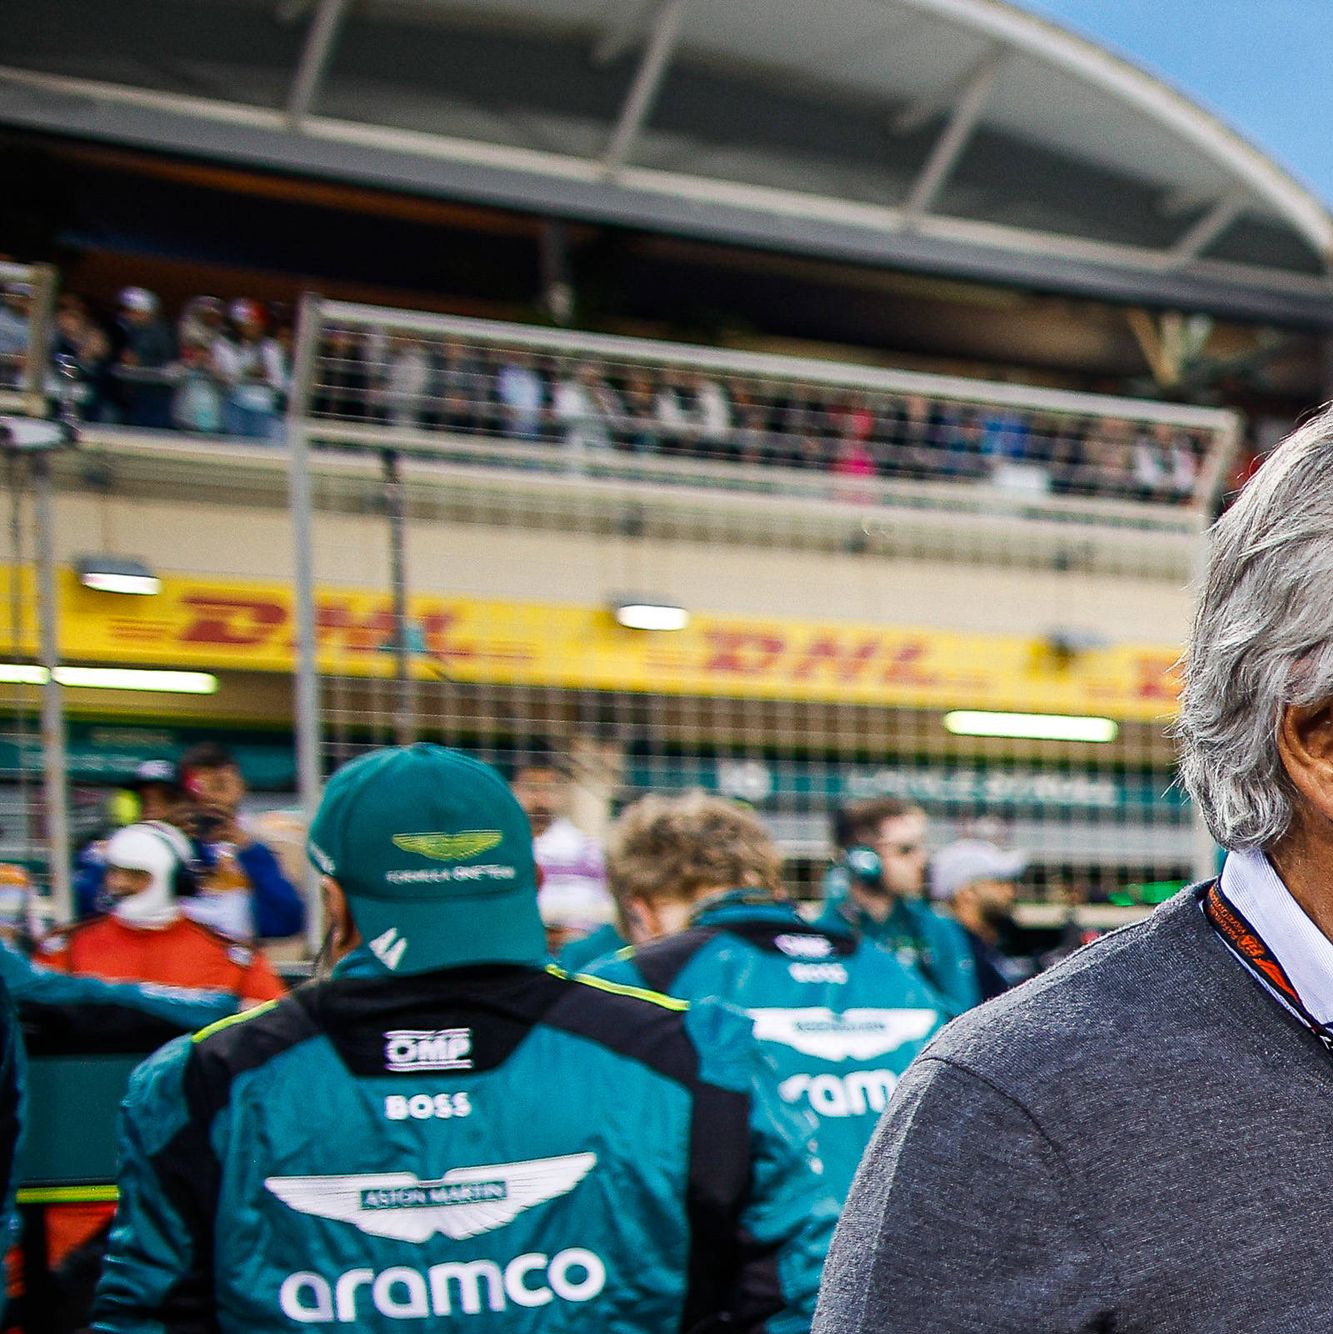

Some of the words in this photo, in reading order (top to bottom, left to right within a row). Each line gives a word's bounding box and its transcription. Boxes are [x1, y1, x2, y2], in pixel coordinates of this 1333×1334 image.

[385, 1036, 471, 1064] OMP
[384, 1092, 472, 1120] BOSS
[365, 1188, 426, 1206] ASTON
[429, 1184, 503, 1202] MARTIN
[280, 1246, 606, 1323] aramco
